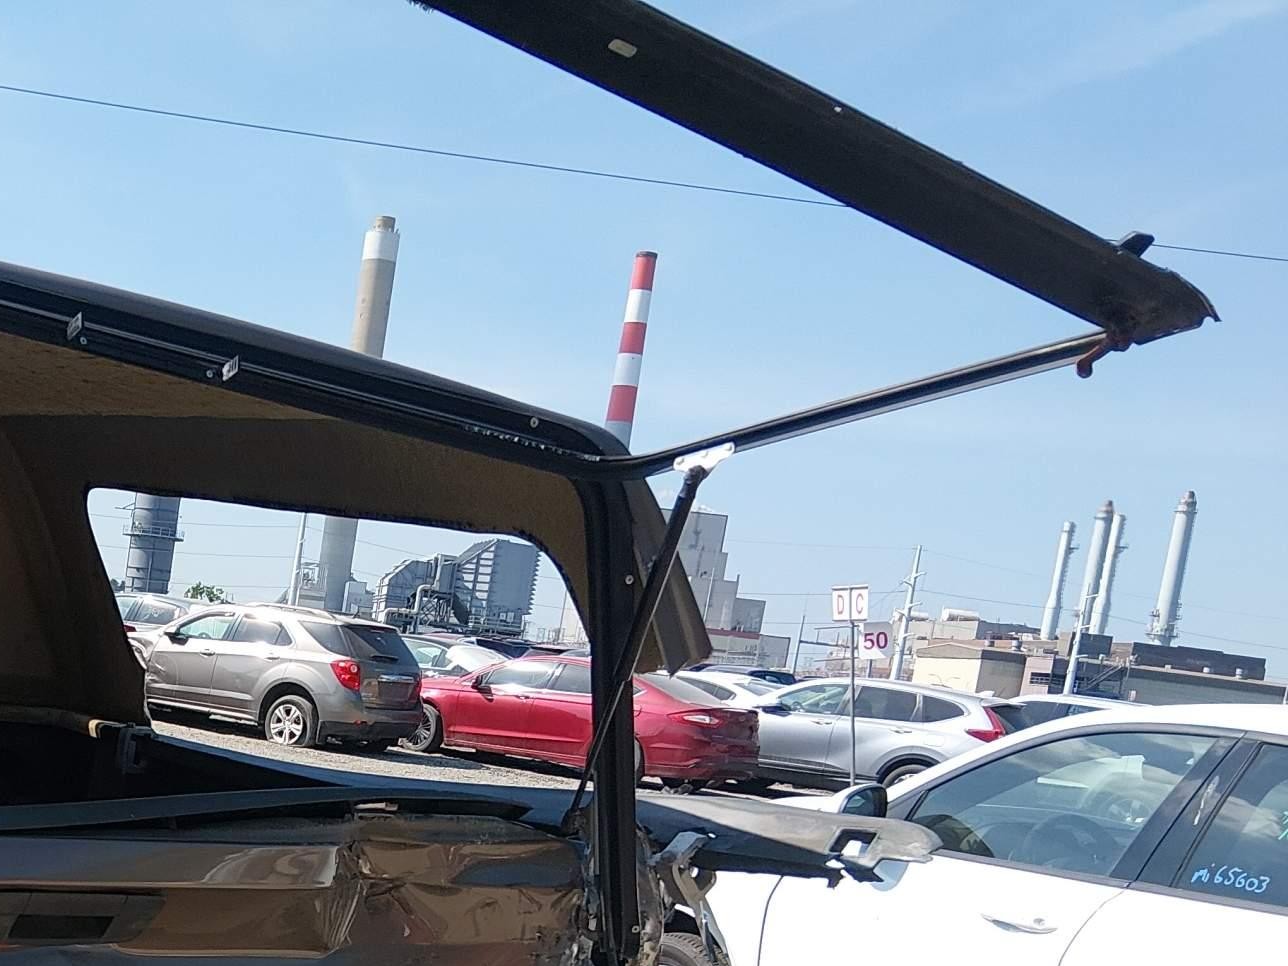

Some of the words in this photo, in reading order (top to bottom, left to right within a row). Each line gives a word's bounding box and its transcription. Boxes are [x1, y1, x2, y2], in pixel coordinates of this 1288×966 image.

[836, 594, 845, 615] D
[855, 593, 864, 615] C
[863, 631, 888, 650] 50
